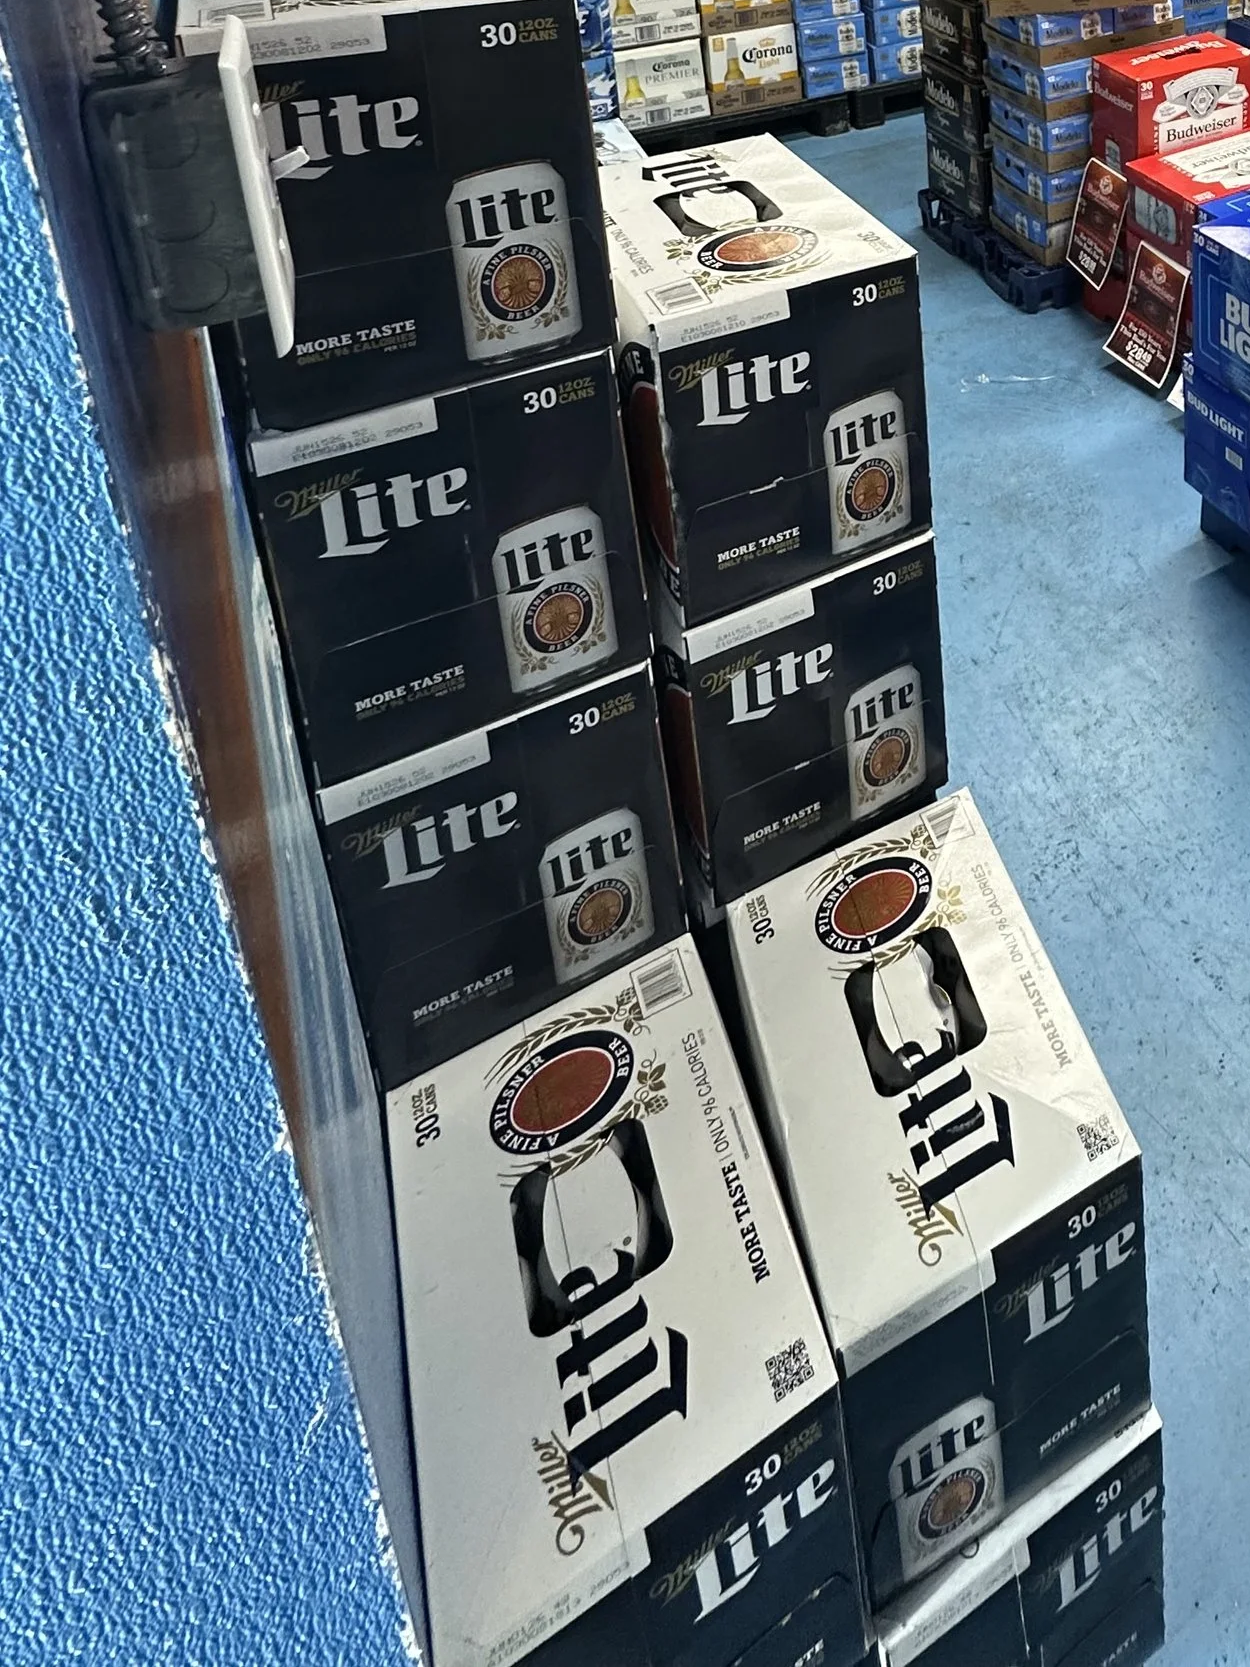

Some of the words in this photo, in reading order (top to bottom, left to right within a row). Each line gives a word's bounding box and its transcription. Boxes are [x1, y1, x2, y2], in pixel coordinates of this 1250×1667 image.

[480, 21, 518, 48] 30
[518, 27, 559, 43] CANS
[742, 44, 793, 63] Corona
[644, 68, 700, 85] PREMIER
[1166, 114, 1237, 142] Budweiser
[455, 187, 558, 248] Lite
[698, 250, 723, 270] BEER
[506, 304, 541, 321] BEER
[1139, 274, 1176, 304] Budweiser
[296, 333, 352, 356] MORE
[356, 318, 417, 343] TASTE
[669, 347, 736, 394] Miller
[558, 388, 595, 405] CANS
[830, 410, 900, 467] Lite
[275, 467, 365, 522] Miller
[318, 466, 472, 559] Lite
[500, 528, 598, 595] Lite
[716, 542, 757, 565] MORE
[758, 526, 801, 550] TASTE
[547, 634, 581, 653] BEER
[354, 685, 408, 714] MORE
[409, 664, 466, 691] TASTE
[727, 642, 835, 726] Lite
[600, 701, 636, 722] CANS
[850, 682, 917, 743] Lite
[380, 790, 522, 891] Lite
[743, 820, 781, 847] MORE
[781, 800, 822, 825] TASTE
[547, 827, 636, 899] Lite
[908, 861, 930, 894] BEER
[755, 894, 766, 917] CANS
[819, 874, 857, 934] PILSNER
[826, 933, 861, 952] FINE
[865, 934, 878, 949] A
[411, 990, 461, 1021] MORE
[462, 964, 514, 994] TASTE
[681, 1032, 713, 1099] CALORIES
[494, 1054, 546, 1130] PILSNER
[702, 1098, 715, 1119] 96
[500, 1130, 540, 1152] FINE
[545, 1132, 560, 1148] A
[709, 1115, 731, 1153] ONLY
[722, 1161, 754, 1222] TASTE
[886, 1168, 965, 1268] Miller
[739, 1221, 770, 1284] MORE
[1022, 1221, 1137, 1345] Lite
[531, 1430, 615, 1557] Miller
[694, 1457, 838, 1625] Lite
